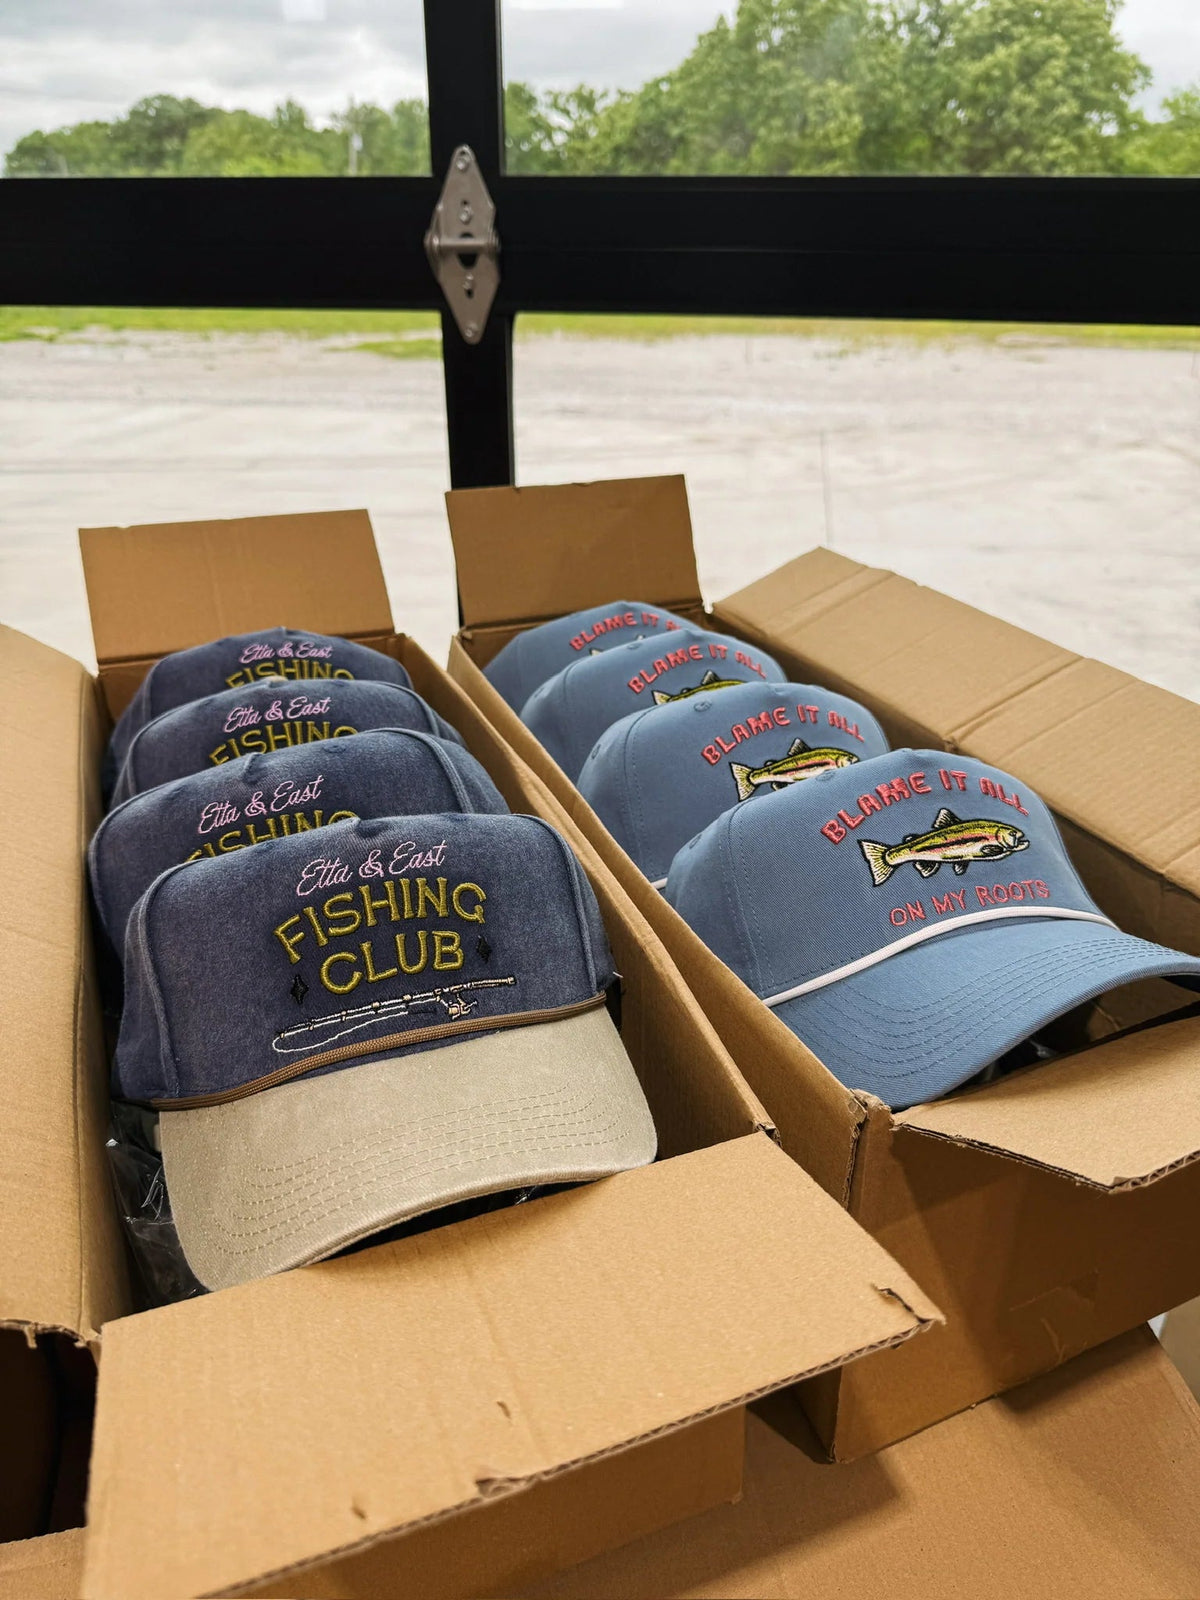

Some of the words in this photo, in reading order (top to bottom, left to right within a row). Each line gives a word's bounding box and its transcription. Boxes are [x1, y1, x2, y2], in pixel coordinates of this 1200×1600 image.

[240, 643, 275, 663] Etta
[278, 642, 294, 657] &
[295, 642, 333, 658] East
[569, 612, 637, 651] BLAME
[641, 612, 659, 627] IT
[627, 645, 703, 694] BLAME
[708, 644, 728, 659] IT
[735, 650, 767, 679] ALL
[224, 705, 262, 733] Etta
[265, 700, 283, 720] &
[286, 696, 331, 718] East
[701, 707, 790, 766] BLAME
[796, 704, 820, 724] IT
[827, 710, 865, 743] ALL
[198, 800, 240, 834] Etta
[244, 791, 267, 817] &
[270, 774, 325, 812] East
[820, 771, 932, 845] BLAME
[939, 769, 967, 791] IT
[979, 777, 1030, 816] ALL
[296, 856, 353, 896] Etta
[359, 849, 385, 878] &
[388, 839, 448, 876] East
[273, 876, 487, 965] FISHING
[889, 900, 926, 927] ON
[931, 888, 967, 915] MY
[975, 879, 1050, 906] ROOTS
[320, 930, 465, 995] CLUB
